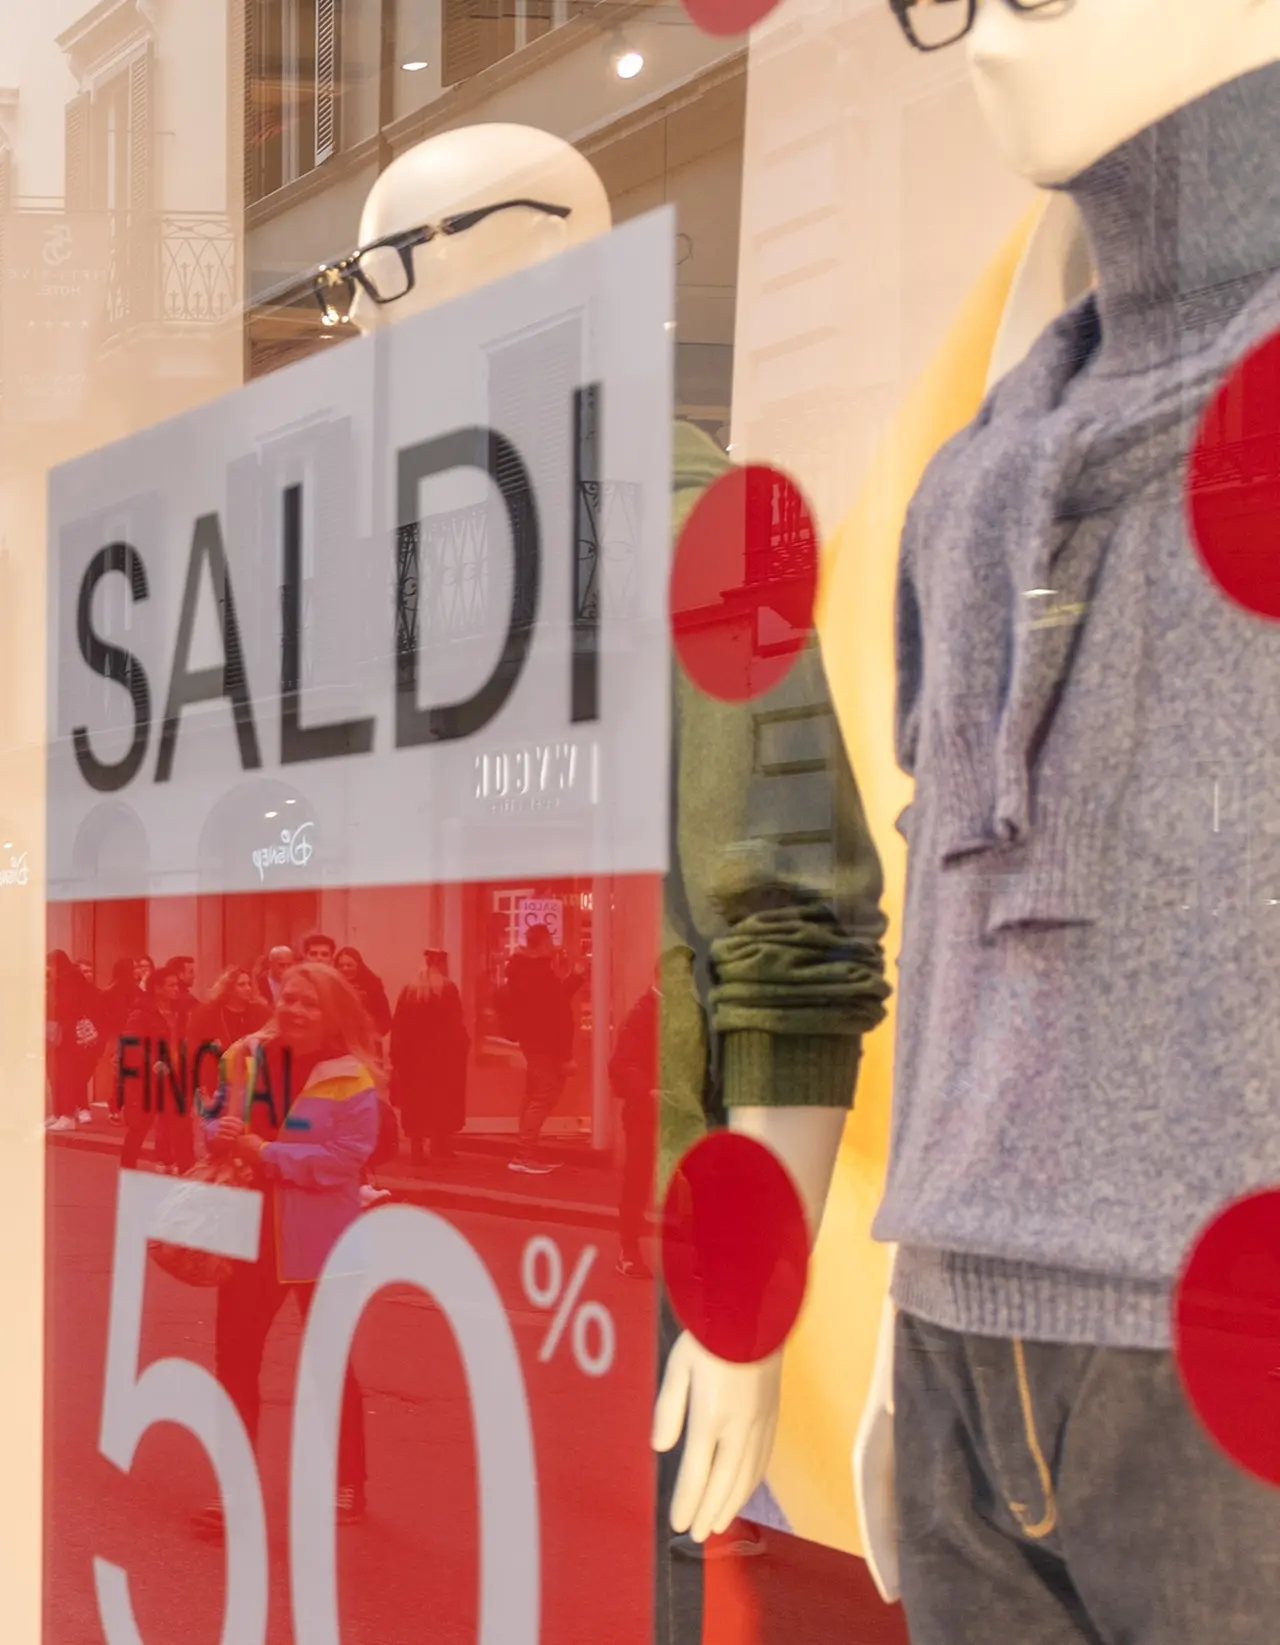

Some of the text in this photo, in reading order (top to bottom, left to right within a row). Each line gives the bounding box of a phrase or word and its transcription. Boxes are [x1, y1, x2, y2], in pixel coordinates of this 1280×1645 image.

[72, 380, 603, 794] SALDI
[116, 1034, 312, 1131] FINO AL
